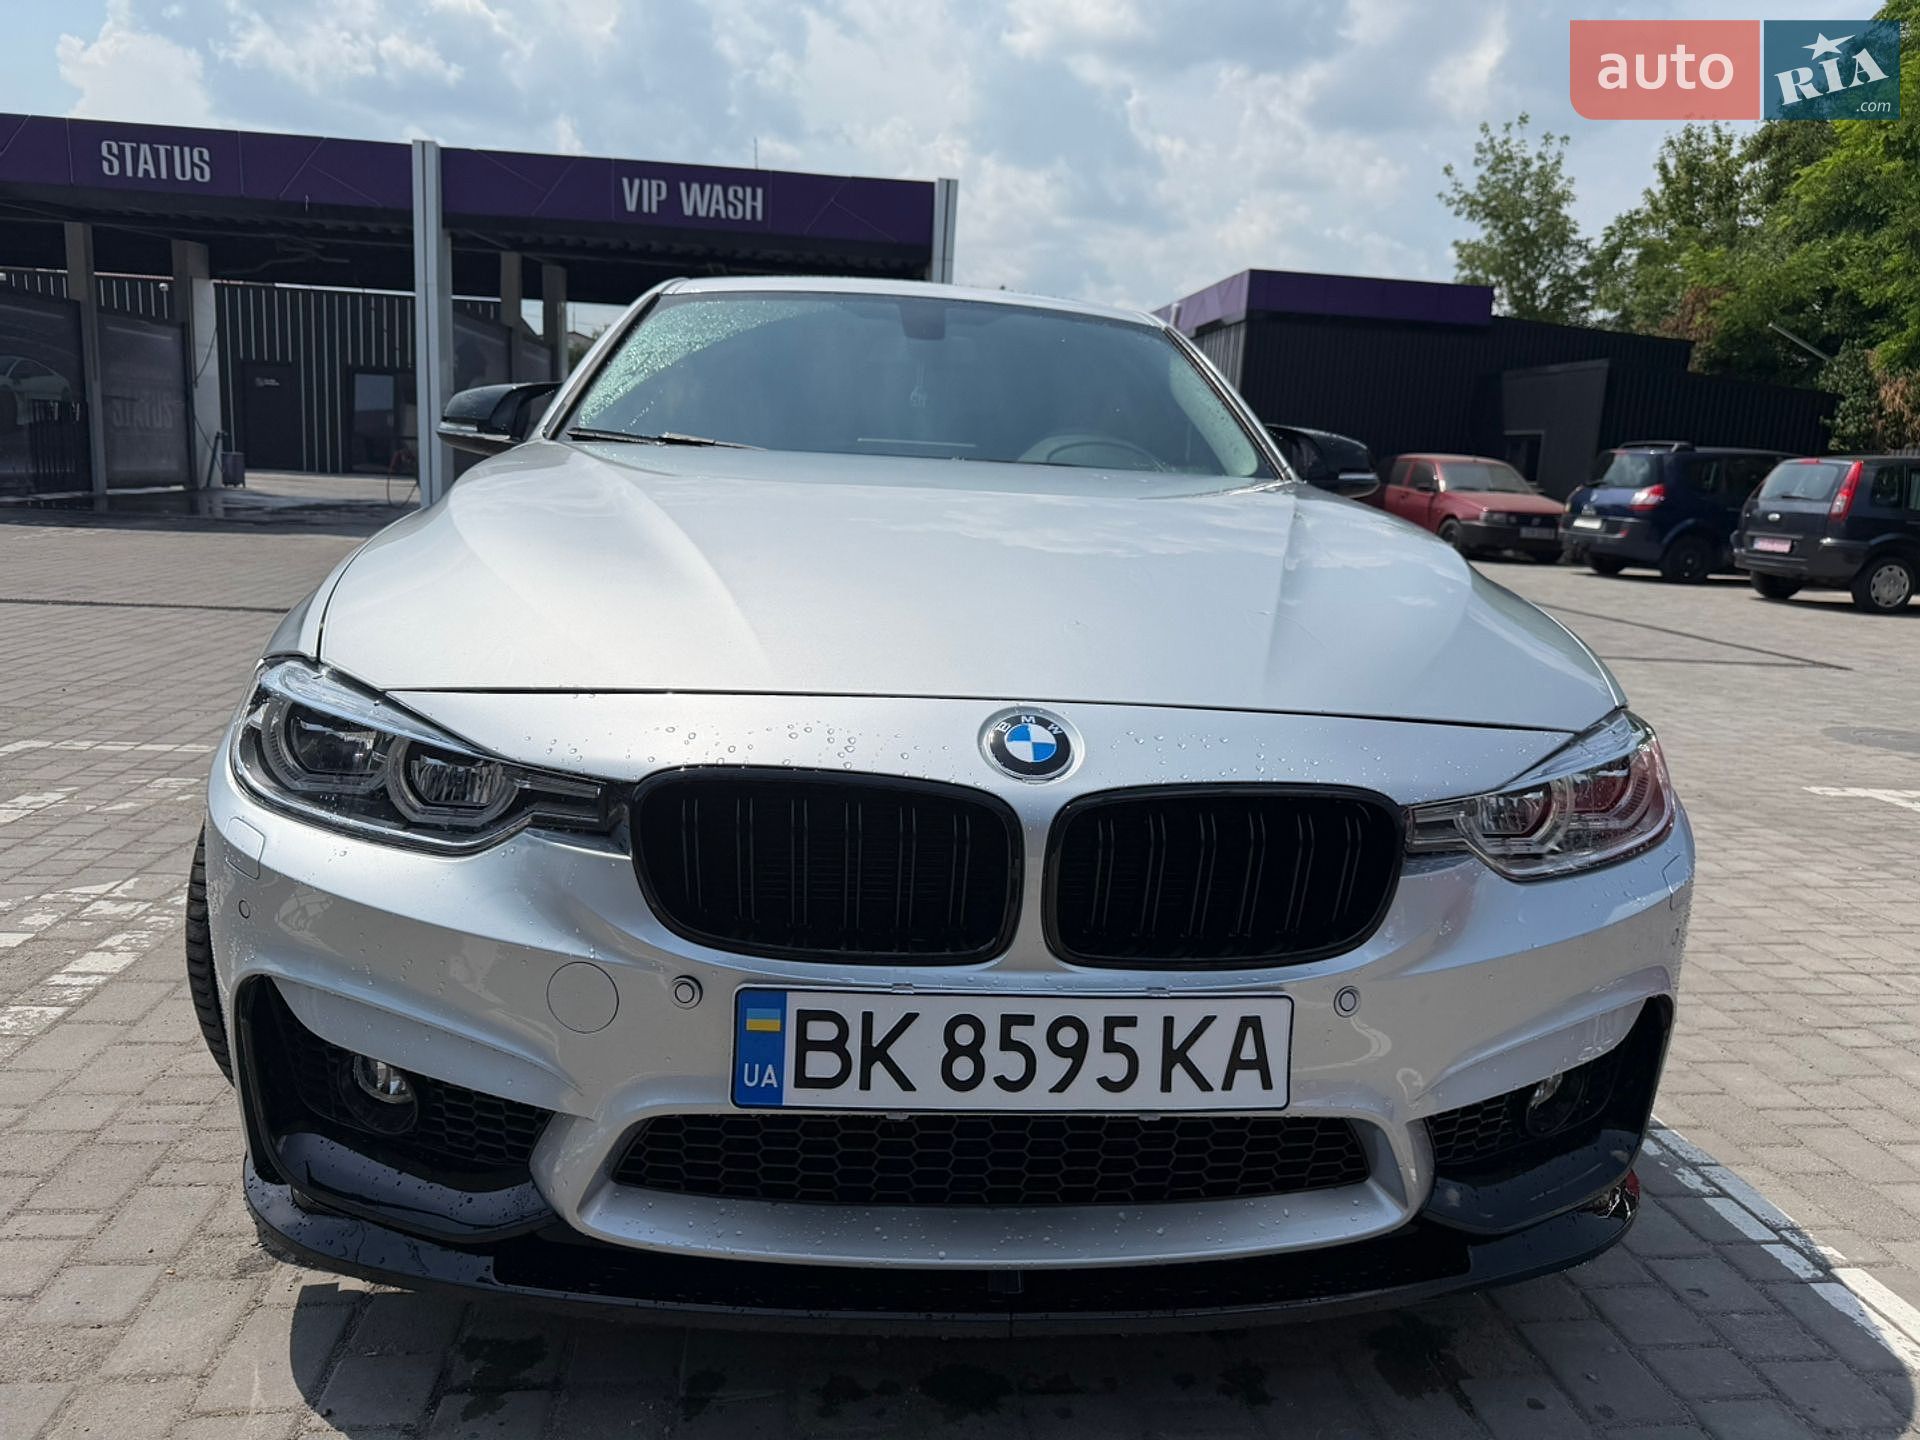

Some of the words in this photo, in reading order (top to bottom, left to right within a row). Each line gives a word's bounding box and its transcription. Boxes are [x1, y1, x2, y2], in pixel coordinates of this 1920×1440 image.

[101, 140, 211, 182] STATUS
[621, 177, 668, 214] VIP
[679, 181, 763, 221] WASH
[995, 715, 1064, 735] BMW
[793, 1008, 920, 1092] BK
[941, 1013, 1139, 1092] 8595
[1159, 1014, 1274, 1093] KA
[743, 1063, 779, 1088] UA
